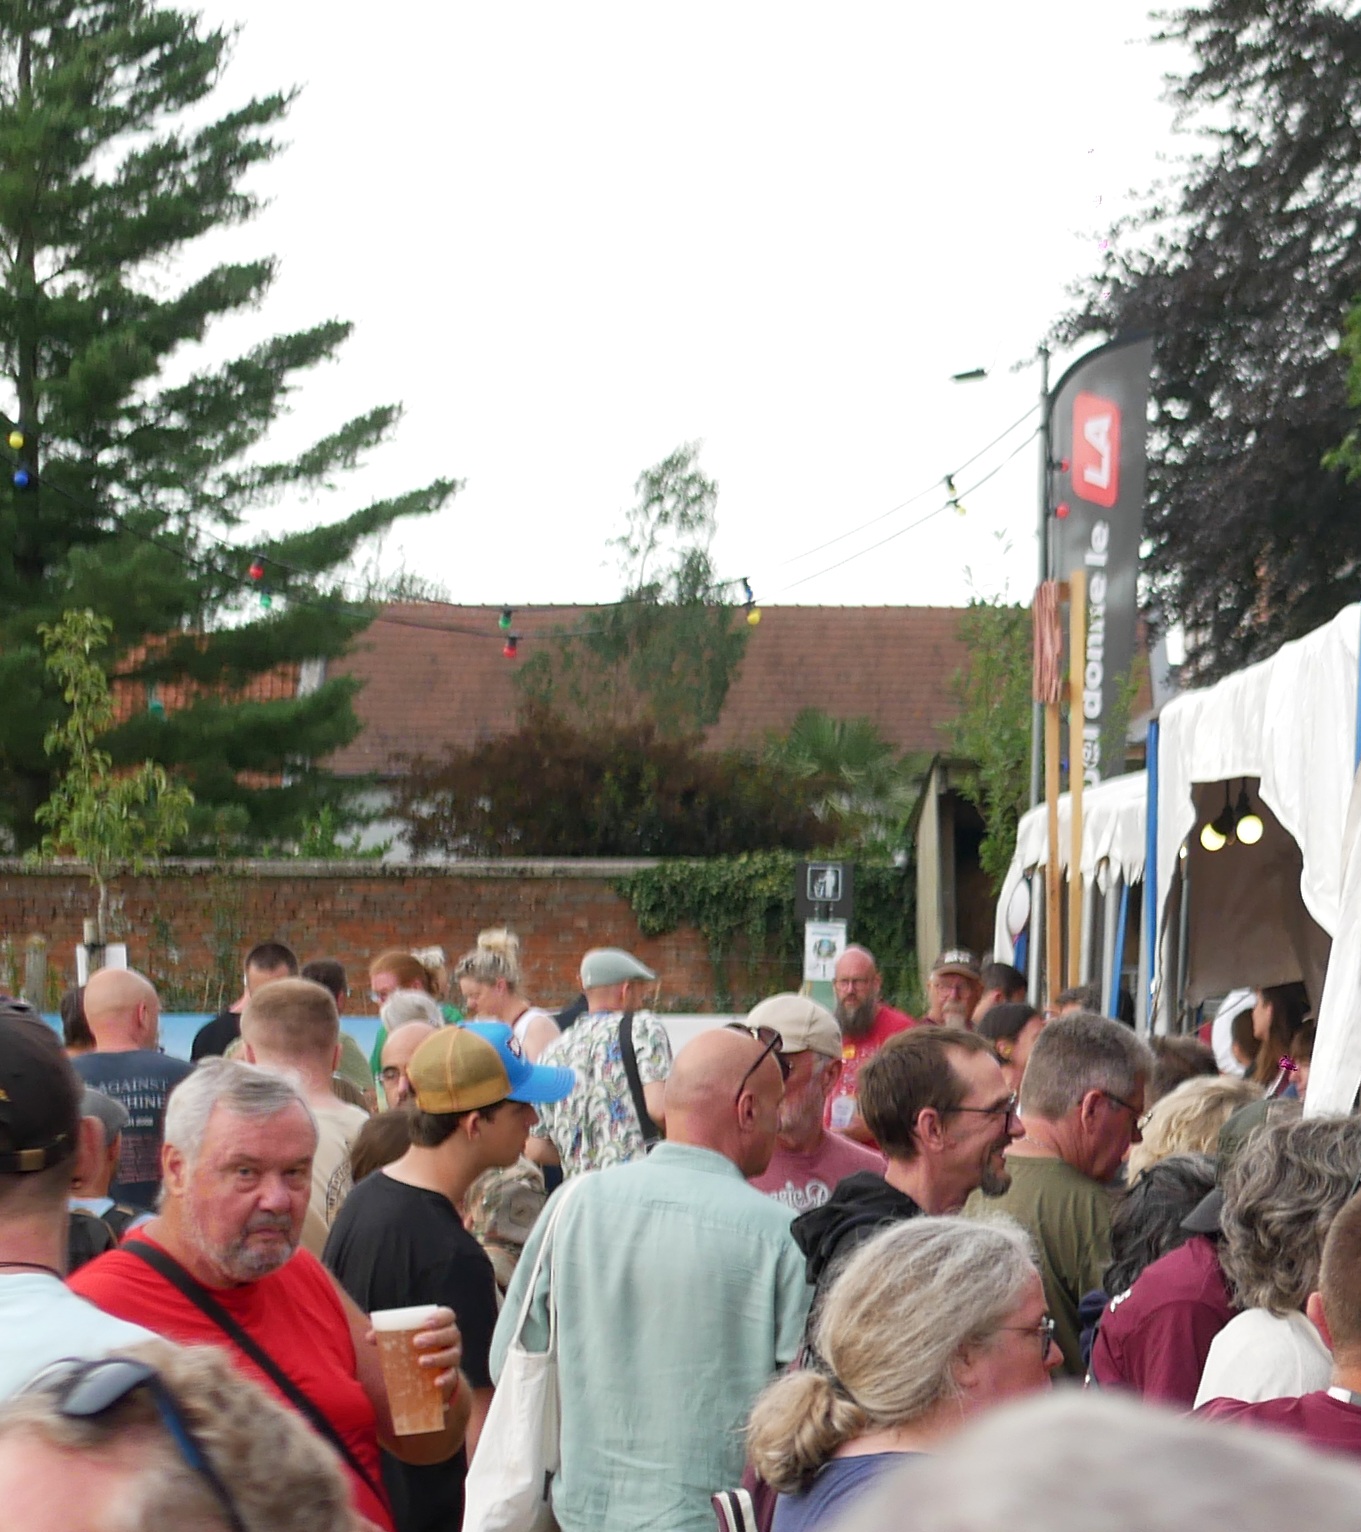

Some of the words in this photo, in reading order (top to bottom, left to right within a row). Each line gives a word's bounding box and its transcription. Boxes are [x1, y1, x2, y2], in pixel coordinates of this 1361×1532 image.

[1083, 414, 1112, 490] LA
[1085, 520, 1109, 567] le
[99, 1078, 168, 1095] AGAINST
[122, 1093, 162, 1110] HINE
